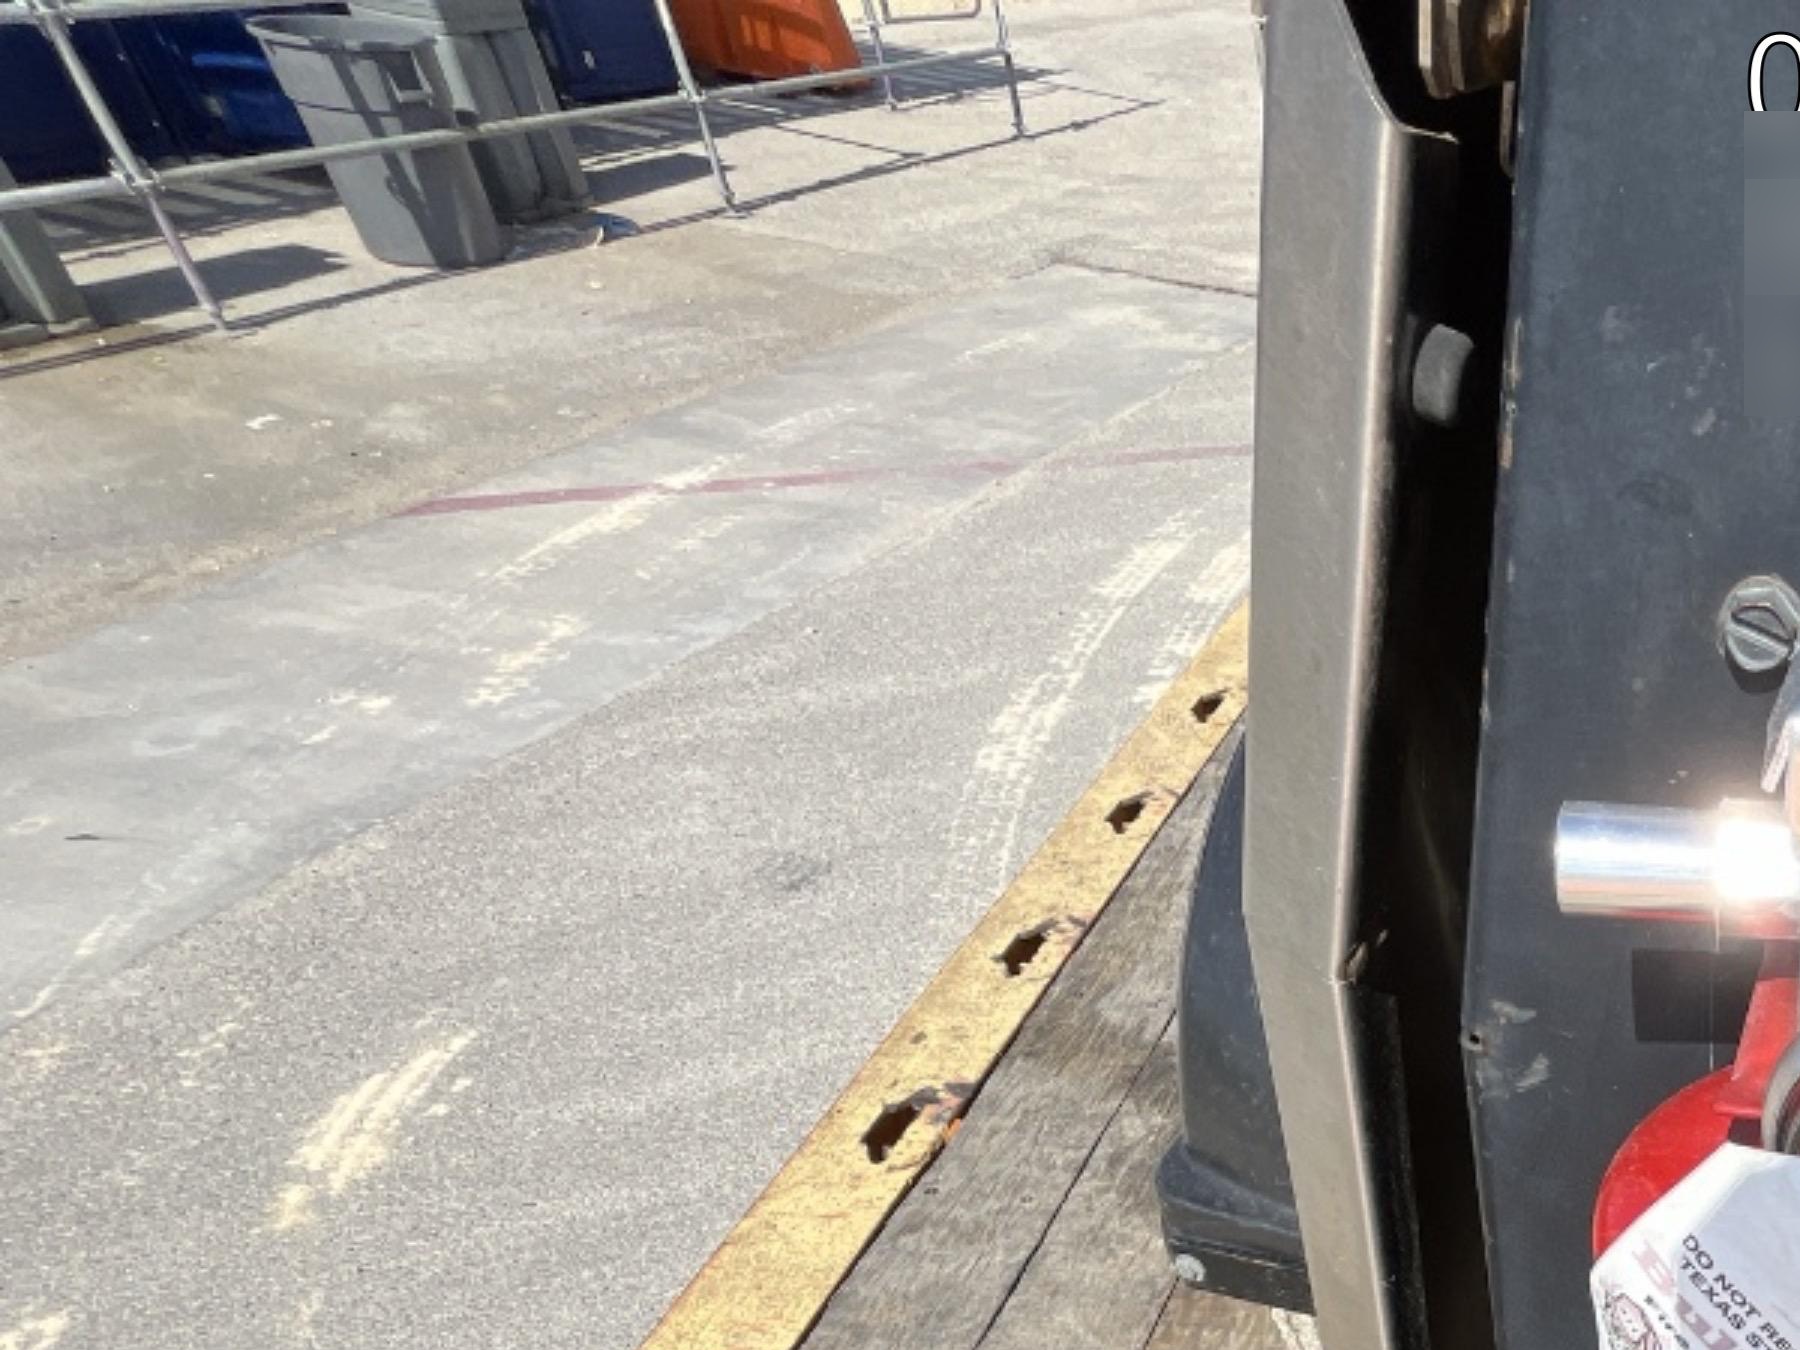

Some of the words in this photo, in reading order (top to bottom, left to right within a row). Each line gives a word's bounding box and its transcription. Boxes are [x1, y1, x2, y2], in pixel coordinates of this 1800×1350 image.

[1680, 1256, 1747, 1330] TEXAS
[1682, 1233, 1714, 1270] DO
[1713, 1271, 1762, 1319] NOT
